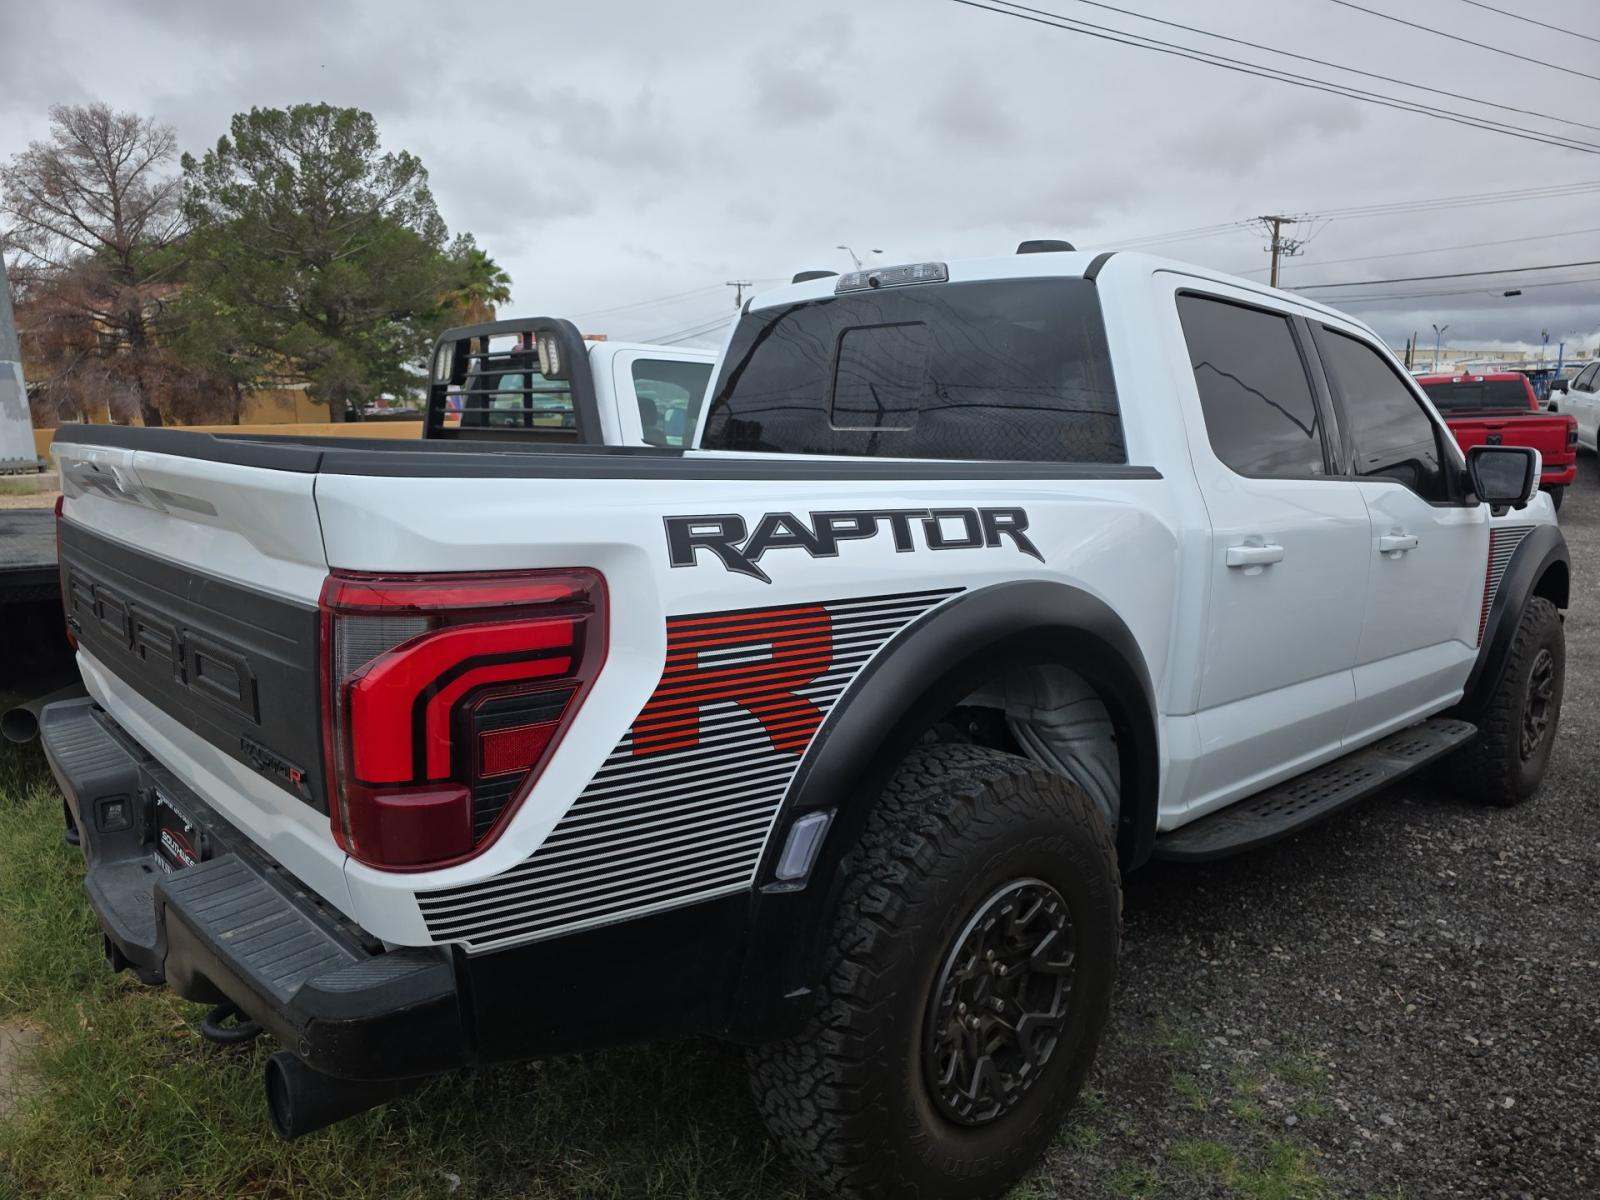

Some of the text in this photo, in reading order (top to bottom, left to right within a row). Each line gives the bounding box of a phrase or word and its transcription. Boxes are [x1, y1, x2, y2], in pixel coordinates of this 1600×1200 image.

[662, 506, 1046, 584] RAPTOR
[69, 568, 261, 726] FORD
[161, 830, 196, 868] SOUTHWES
